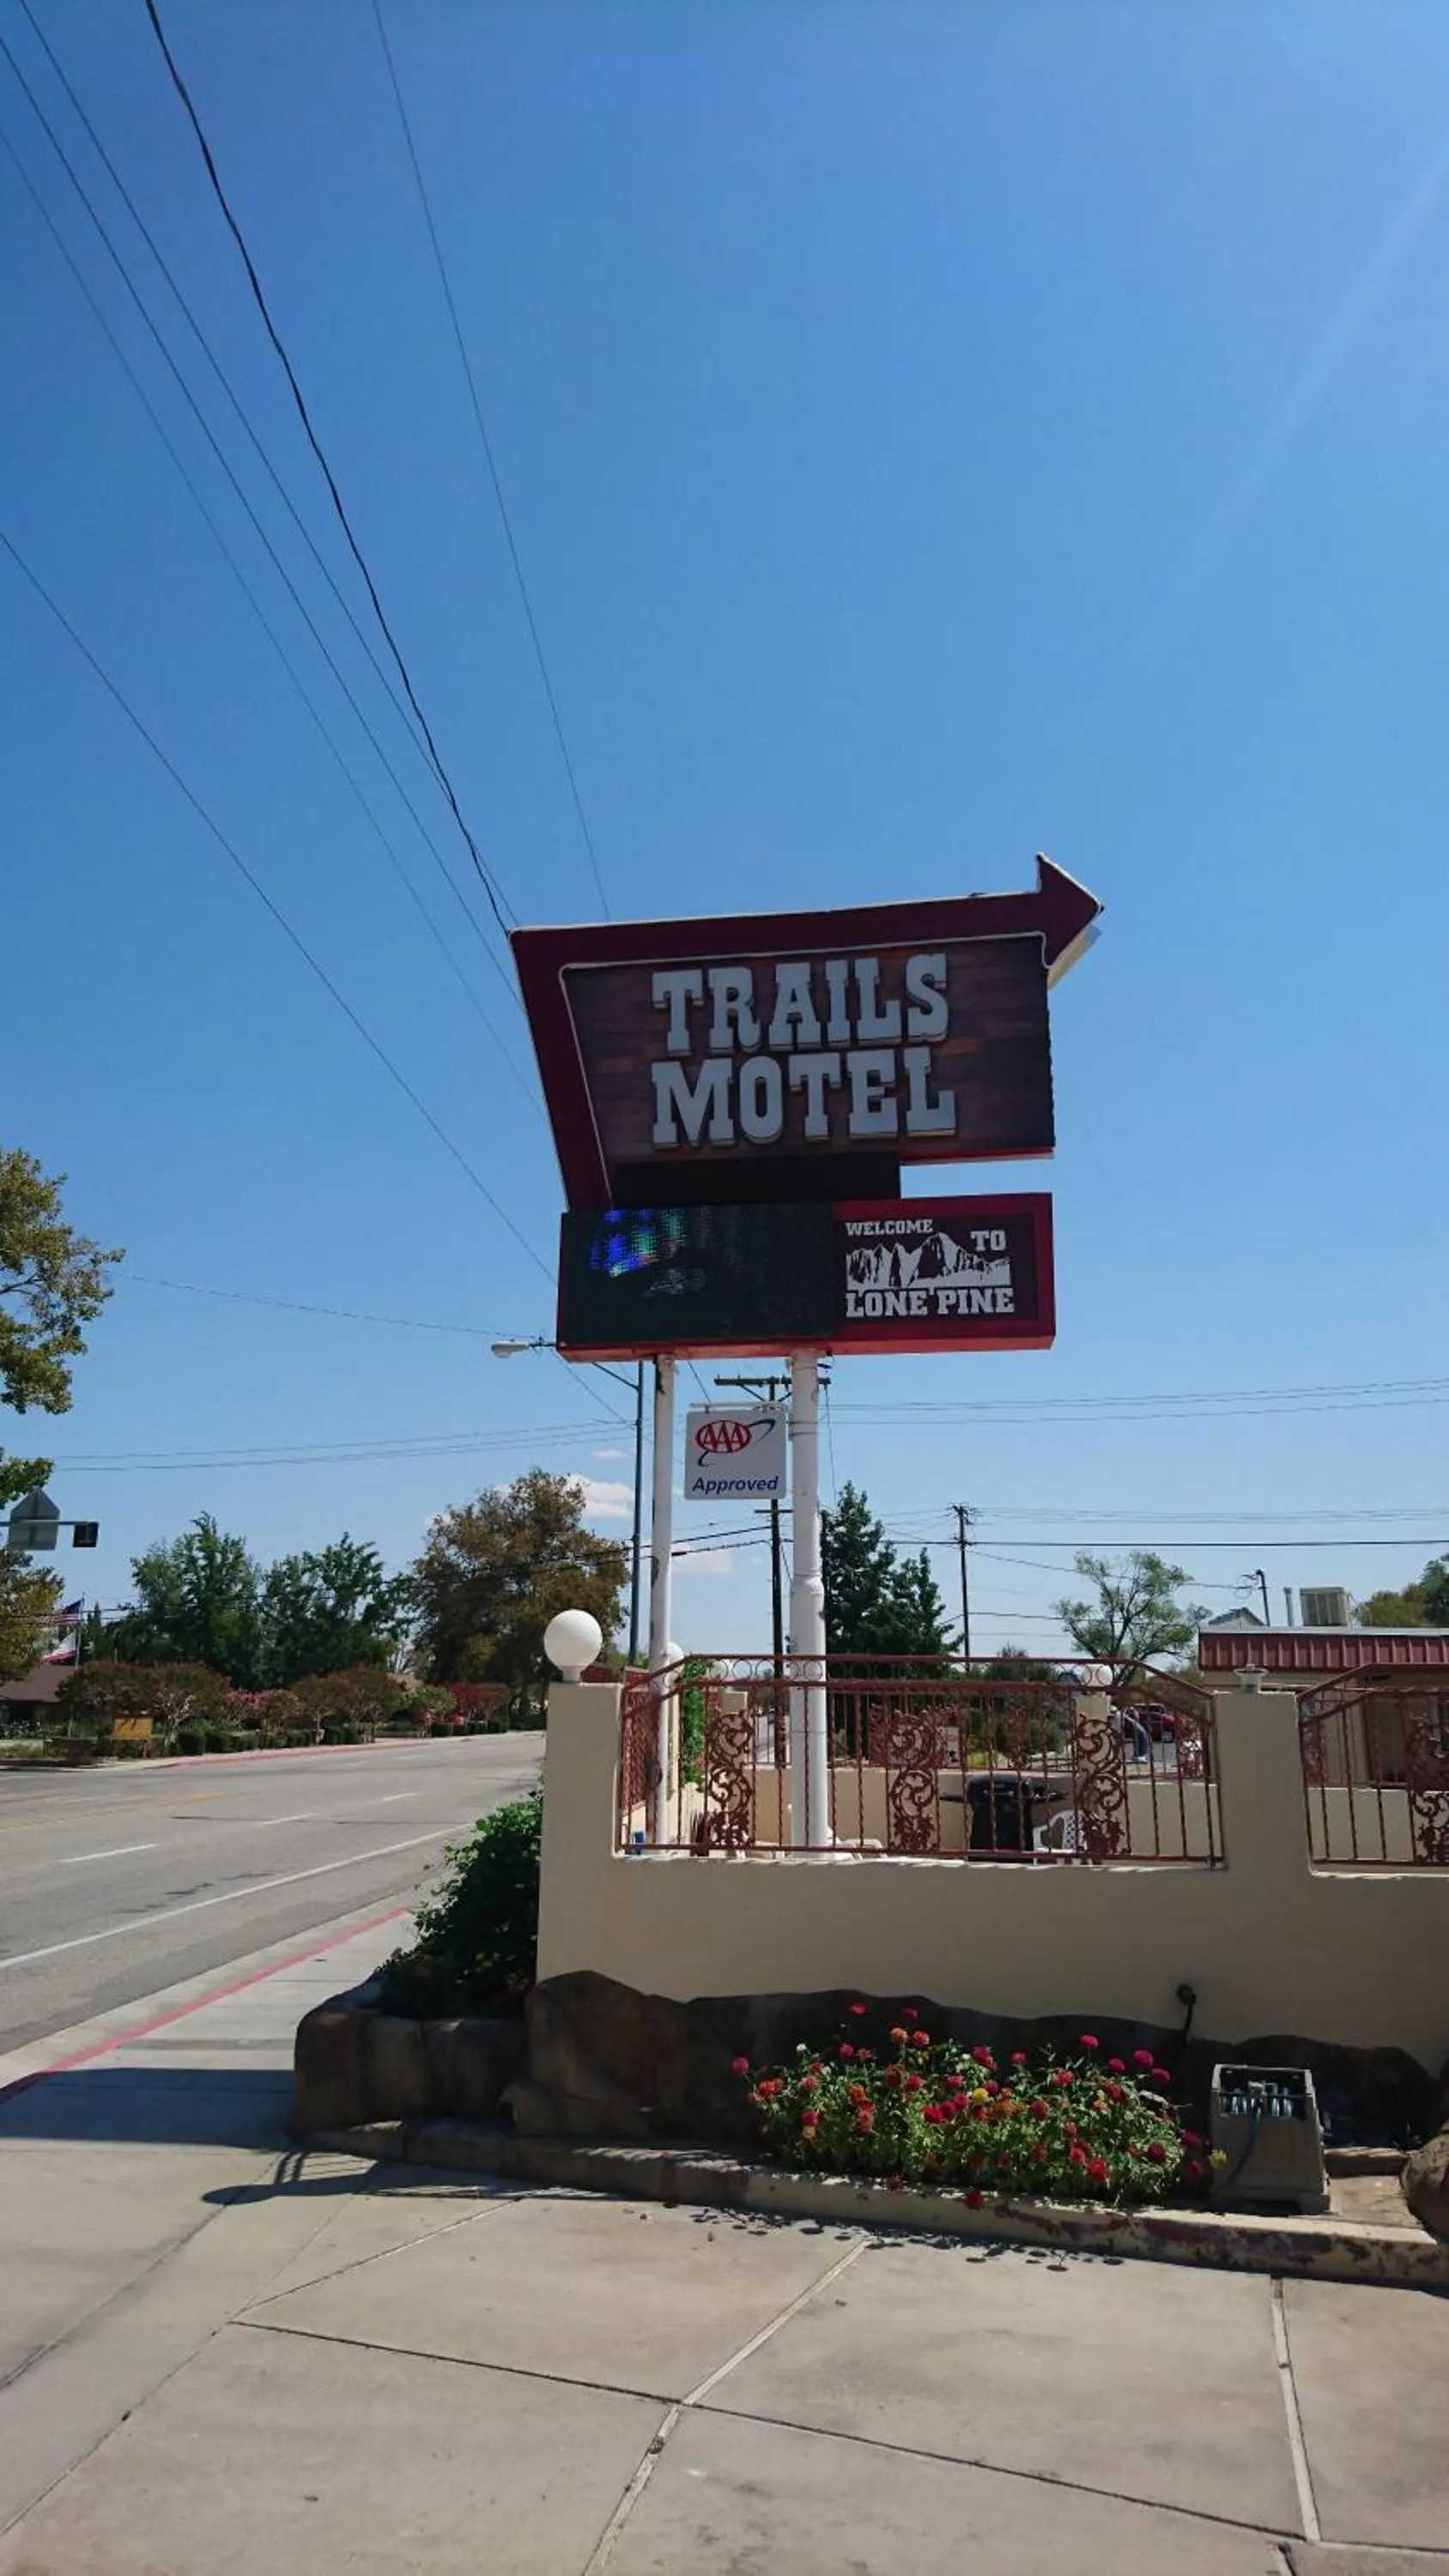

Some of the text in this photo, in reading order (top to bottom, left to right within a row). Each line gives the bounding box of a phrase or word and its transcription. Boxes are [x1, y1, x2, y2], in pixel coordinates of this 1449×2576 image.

[652, 954, 950, 1056] TRAILS
[651, 1048, 956, 1149] MOTEL
[845, 1219, 933, 1236] WELCOME
[970, 1230, 1006, 1251] TO
[845, 1288, 1015, 1317] LONE PINE
[692, 1476, 779, 1494] Approved
